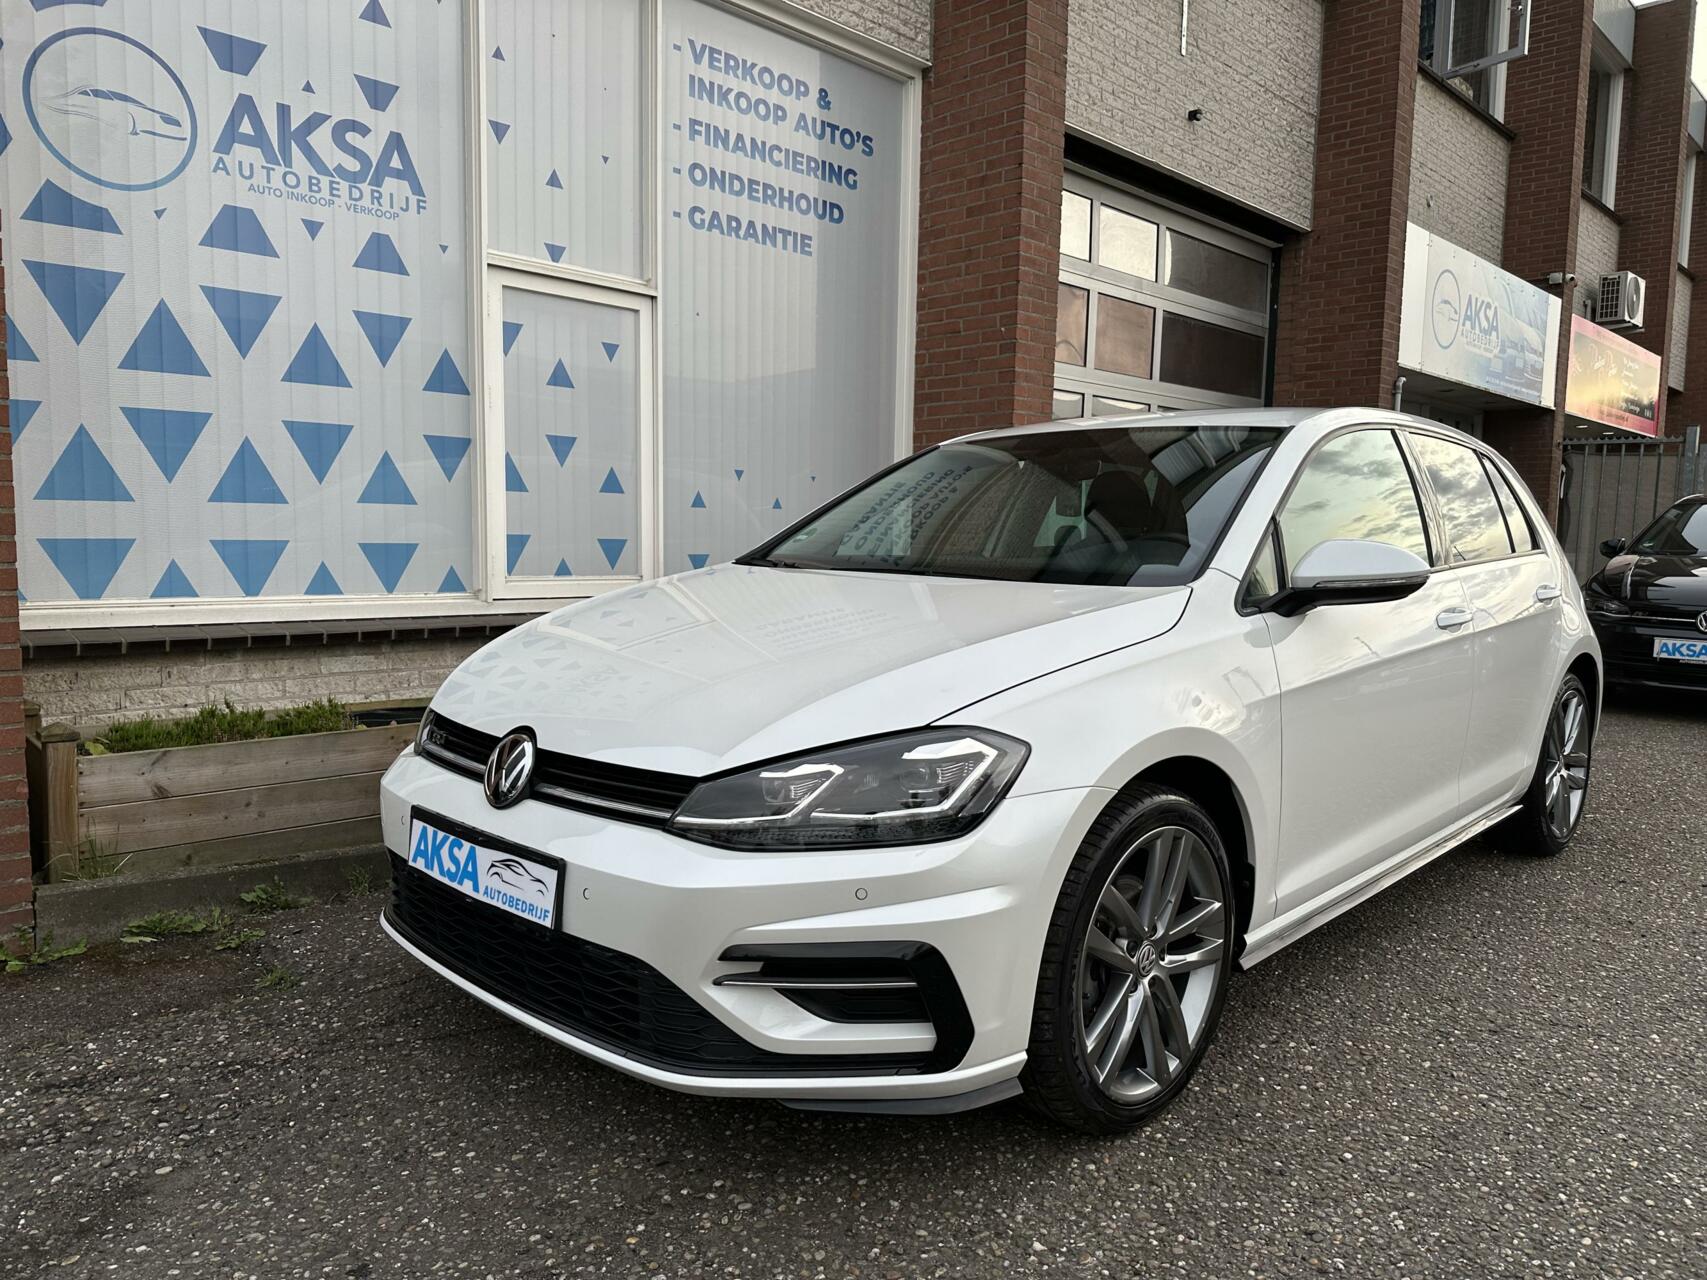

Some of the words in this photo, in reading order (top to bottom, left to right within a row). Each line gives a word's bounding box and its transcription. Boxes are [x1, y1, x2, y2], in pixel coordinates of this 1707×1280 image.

[687, 38, 810, 101] VERKOOP
[816, 87, 832, 112] &
[213, 93, 426, 198] AKSA
[688, 74, 787, 126] INKOOP
[793, 112, 874, 157] AUTO'S
[688, 117, 858, 191] FINANCIERING
[212, 156, 428, 216] AUTOBEDRIJF
[247, 183, 283, 200] AUTO
[286, 191, 336, 209] INKOOP
[344, 202, 400, 222] VERKOOP
[687, 162, 845, 225] ONDERHOUD
[687, 205, 813, 257] GARANTIE
[1462, 294, 1500, 339] AKSA
[1660, 642, 1707, 658] AKSA
[411, 825, 480, 894] AKSA
[483, 885, 550, 922] AUTOBEDRIJF
